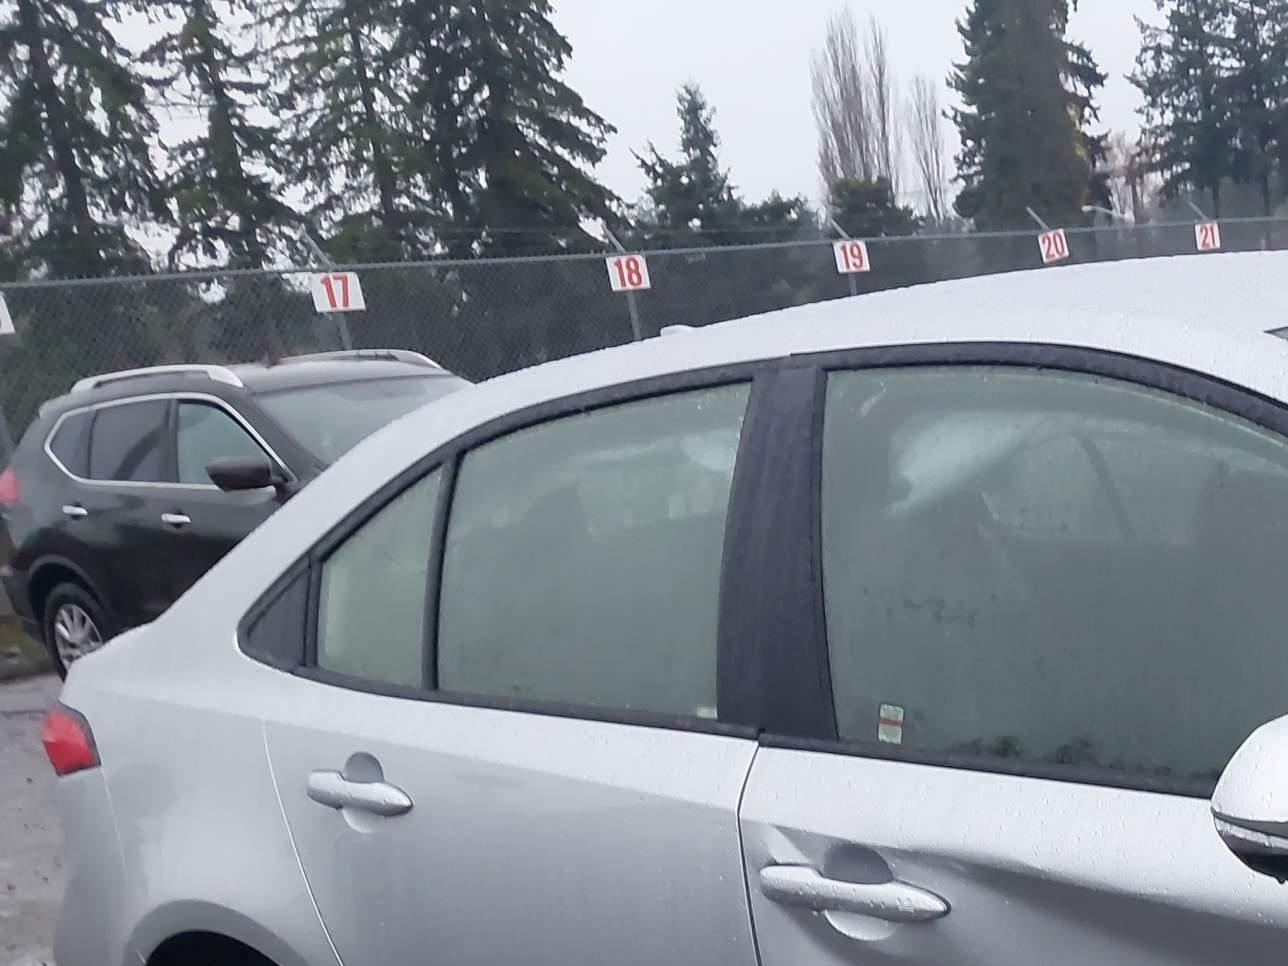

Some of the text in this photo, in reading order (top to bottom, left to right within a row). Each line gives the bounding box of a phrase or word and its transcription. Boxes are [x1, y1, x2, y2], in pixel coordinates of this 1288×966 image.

[1042, 232, 1064, 258] 20
[1200, 225, 1216, 248] 21
[840, 242, 863, 269] 19
[614, 256, 642, 287] 18
[320, 275, 349, 308] 17
